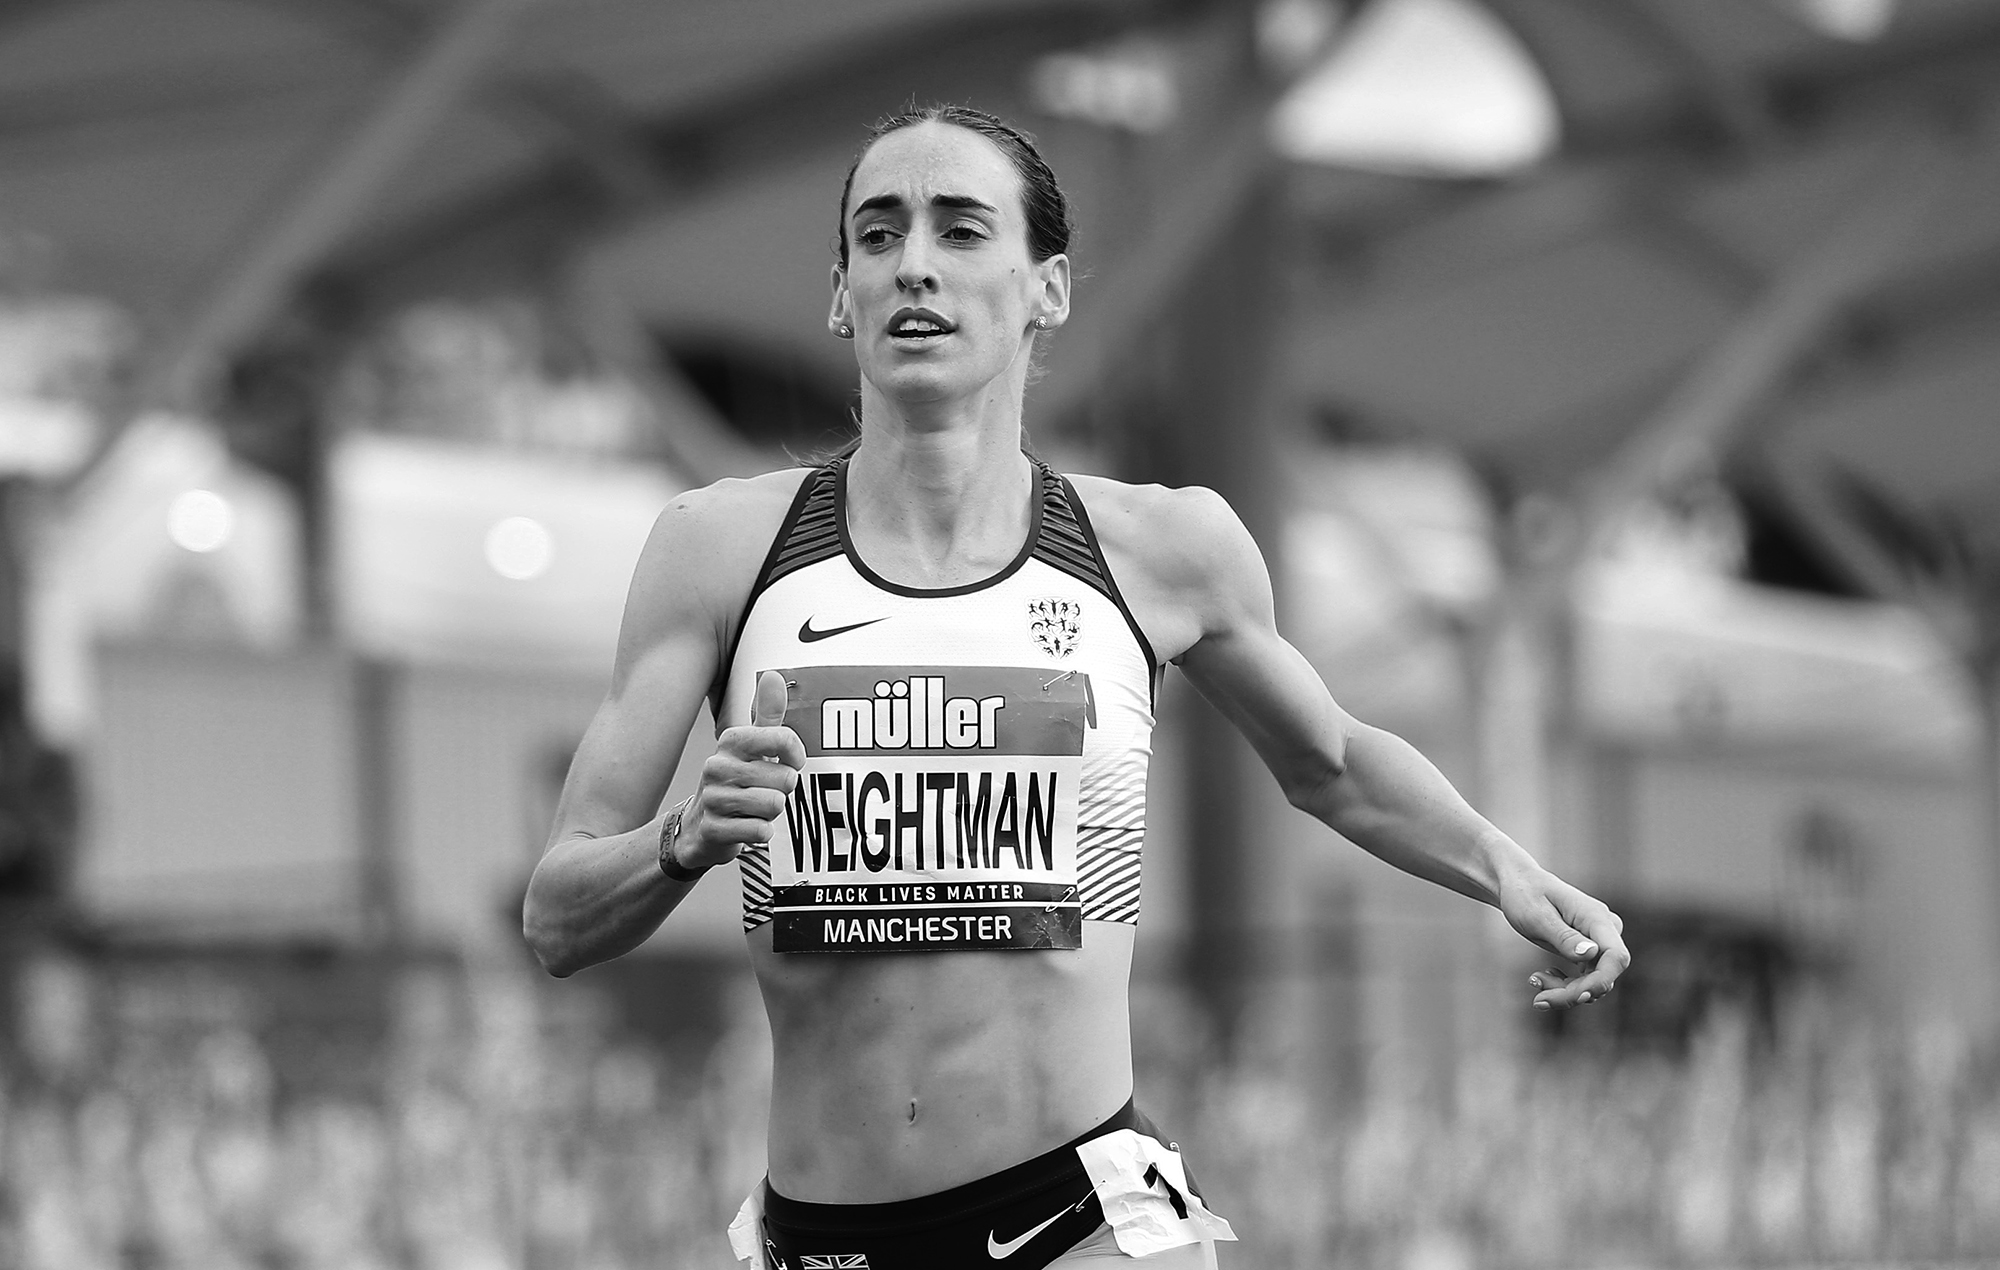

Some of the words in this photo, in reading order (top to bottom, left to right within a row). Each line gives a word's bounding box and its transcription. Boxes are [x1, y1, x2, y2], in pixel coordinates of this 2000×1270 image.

[821, 676, 1005, 750] müller
[785, 771, 1058, 874] WEIGHTMAN
[815, 887, 868, 903] BLACK
[879, 886, 936, 902] LIVES
[947, 884, 1024, 901] MATTER
[823, 915, 1012, 943] MANCHESTER
